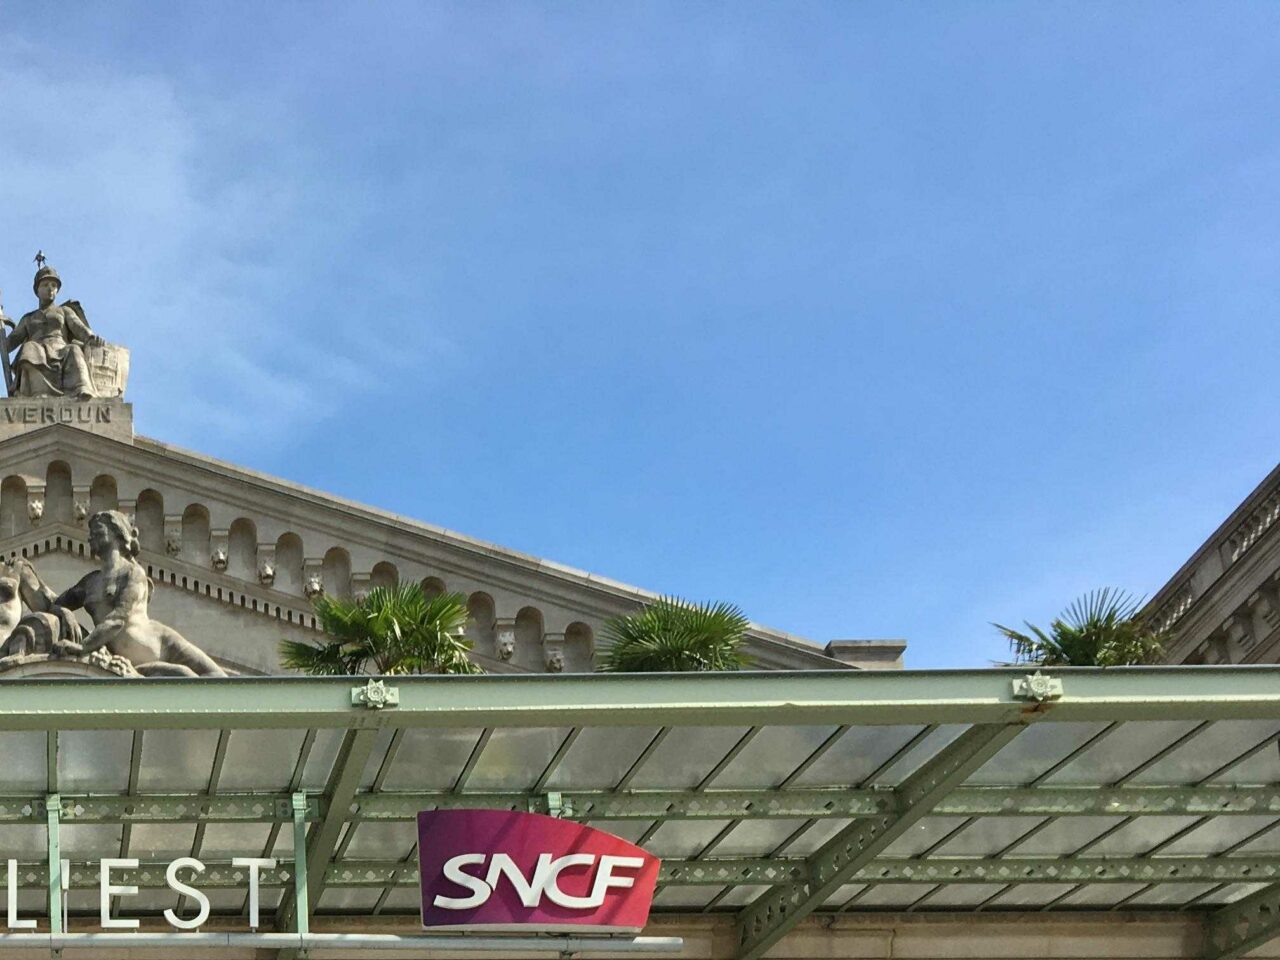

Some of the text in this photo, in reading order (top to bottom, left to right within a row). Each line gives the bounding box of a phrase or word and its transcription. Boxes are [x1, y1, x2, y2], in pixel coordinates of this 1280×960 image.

[4, 405, 112, 424] VERDUN
[7, 856, 277, 930] L'EST
[433, 852, 645, 911] SNCF
